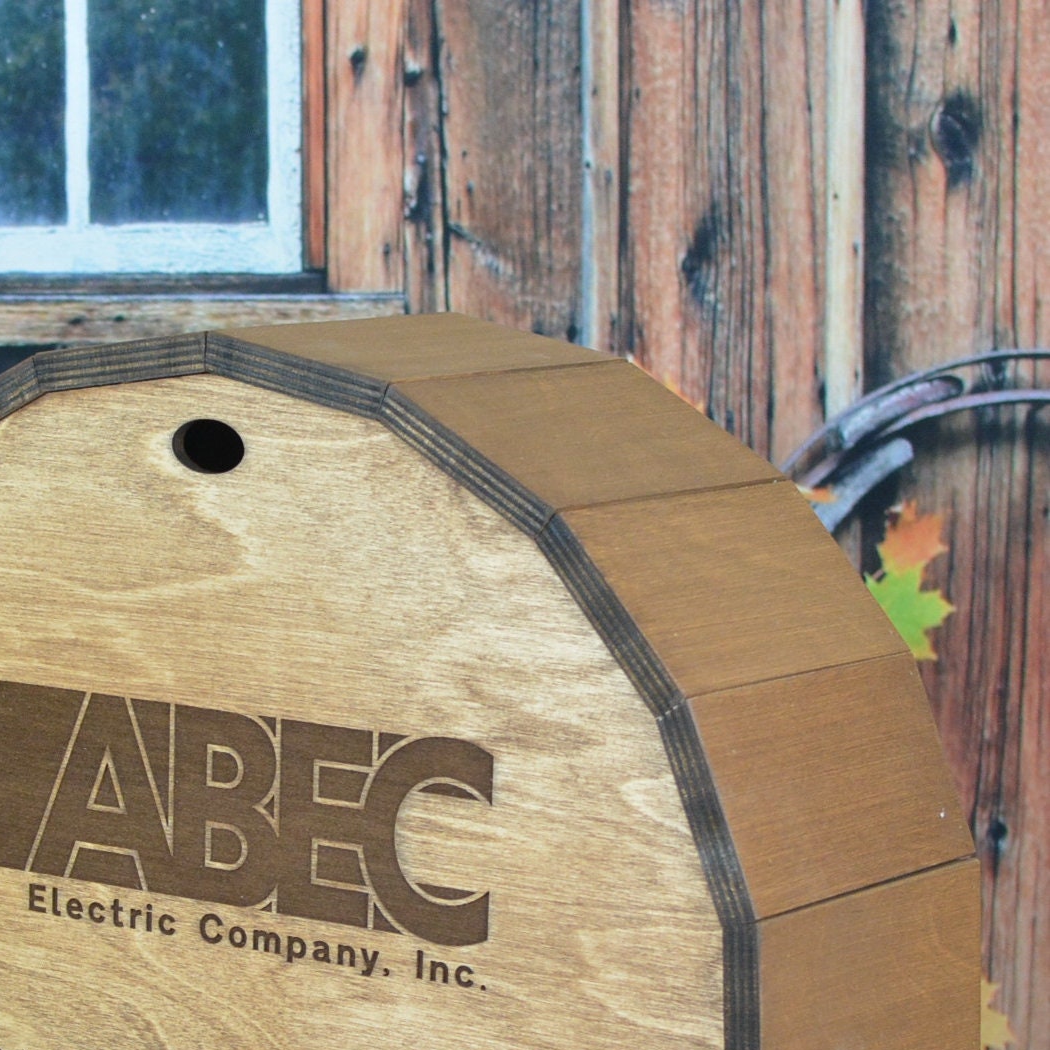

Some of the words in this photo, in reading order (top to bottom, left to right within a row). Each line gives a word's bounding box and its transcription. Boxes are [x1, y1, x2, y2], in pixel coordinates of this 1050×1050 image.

[27, 691, 494, 947] ABEC
[28, 883, 176, 936] Electric
[198, 914, 391, 977] Company,
[415, 950, 488, 991] Inc.
